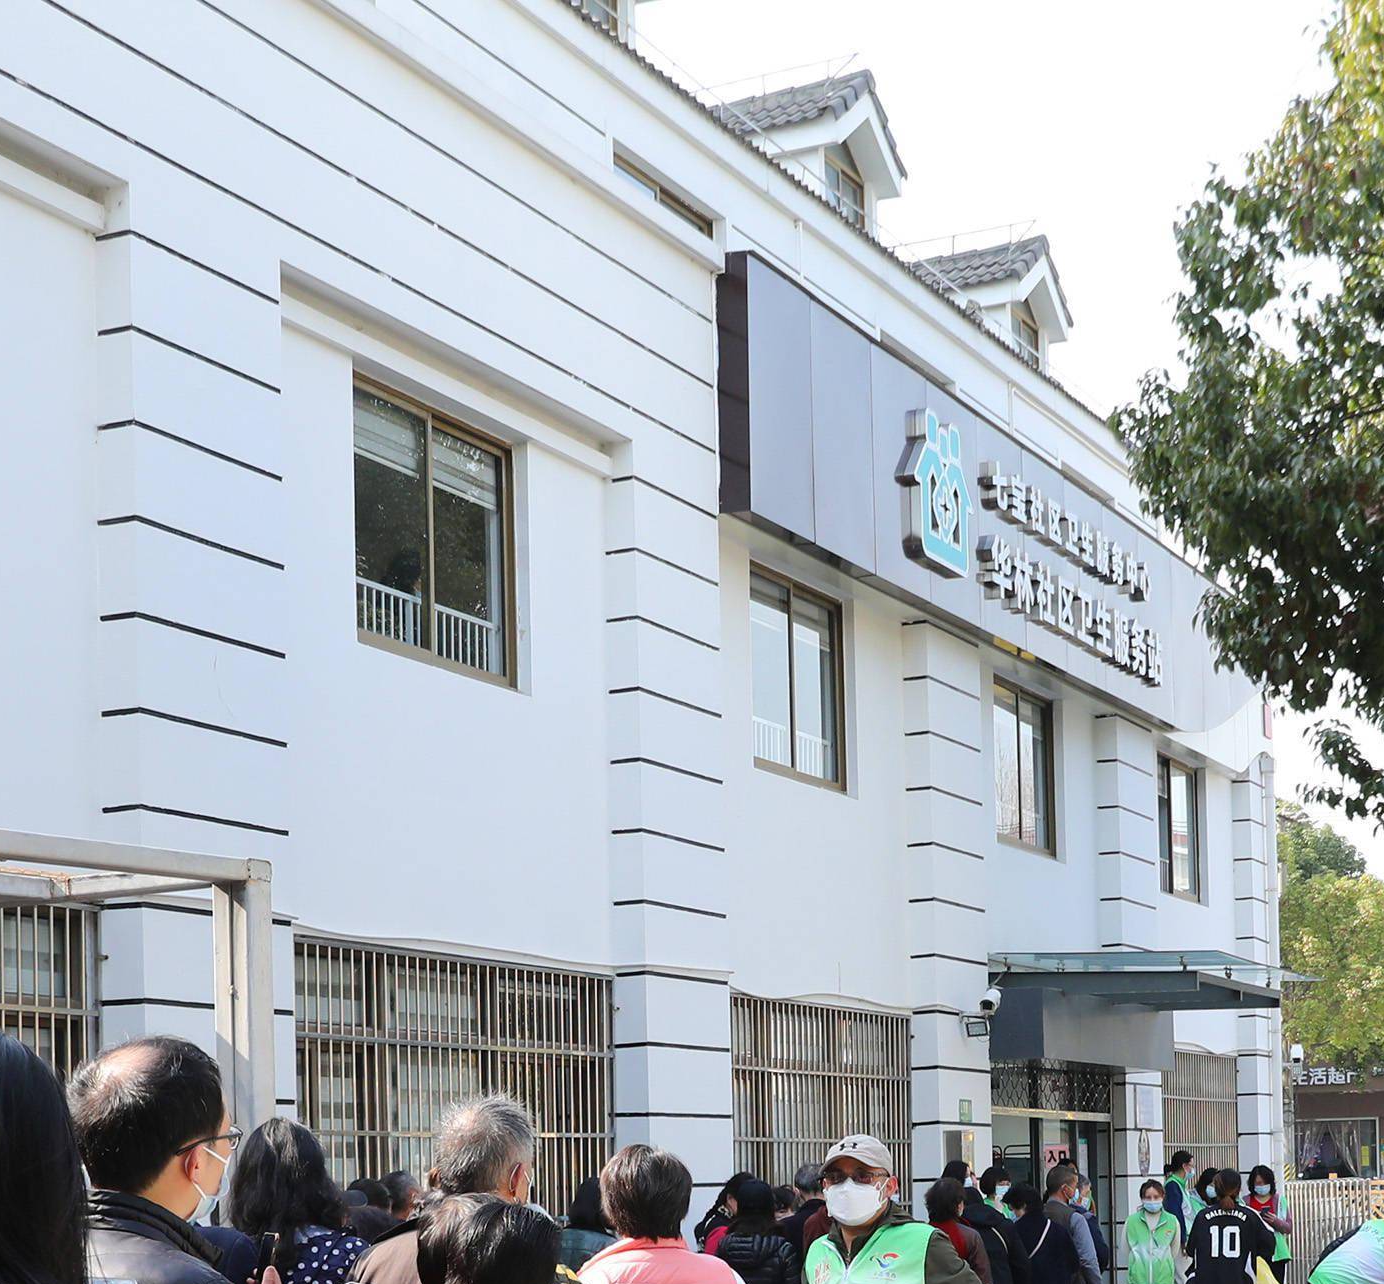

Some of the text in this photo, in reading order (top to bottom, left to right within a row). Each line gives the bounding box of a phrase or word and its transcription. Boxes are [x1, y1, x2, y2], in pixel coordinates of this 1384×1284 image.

[990, 460, 1151, 603] 七宝社区卫生服务中心
[990, 533, 1163, 687] 华林社区卫生服务站
[1047, 1150, 1066, 1163] 入口
[1209, 1225, 1241, 1258] 10
